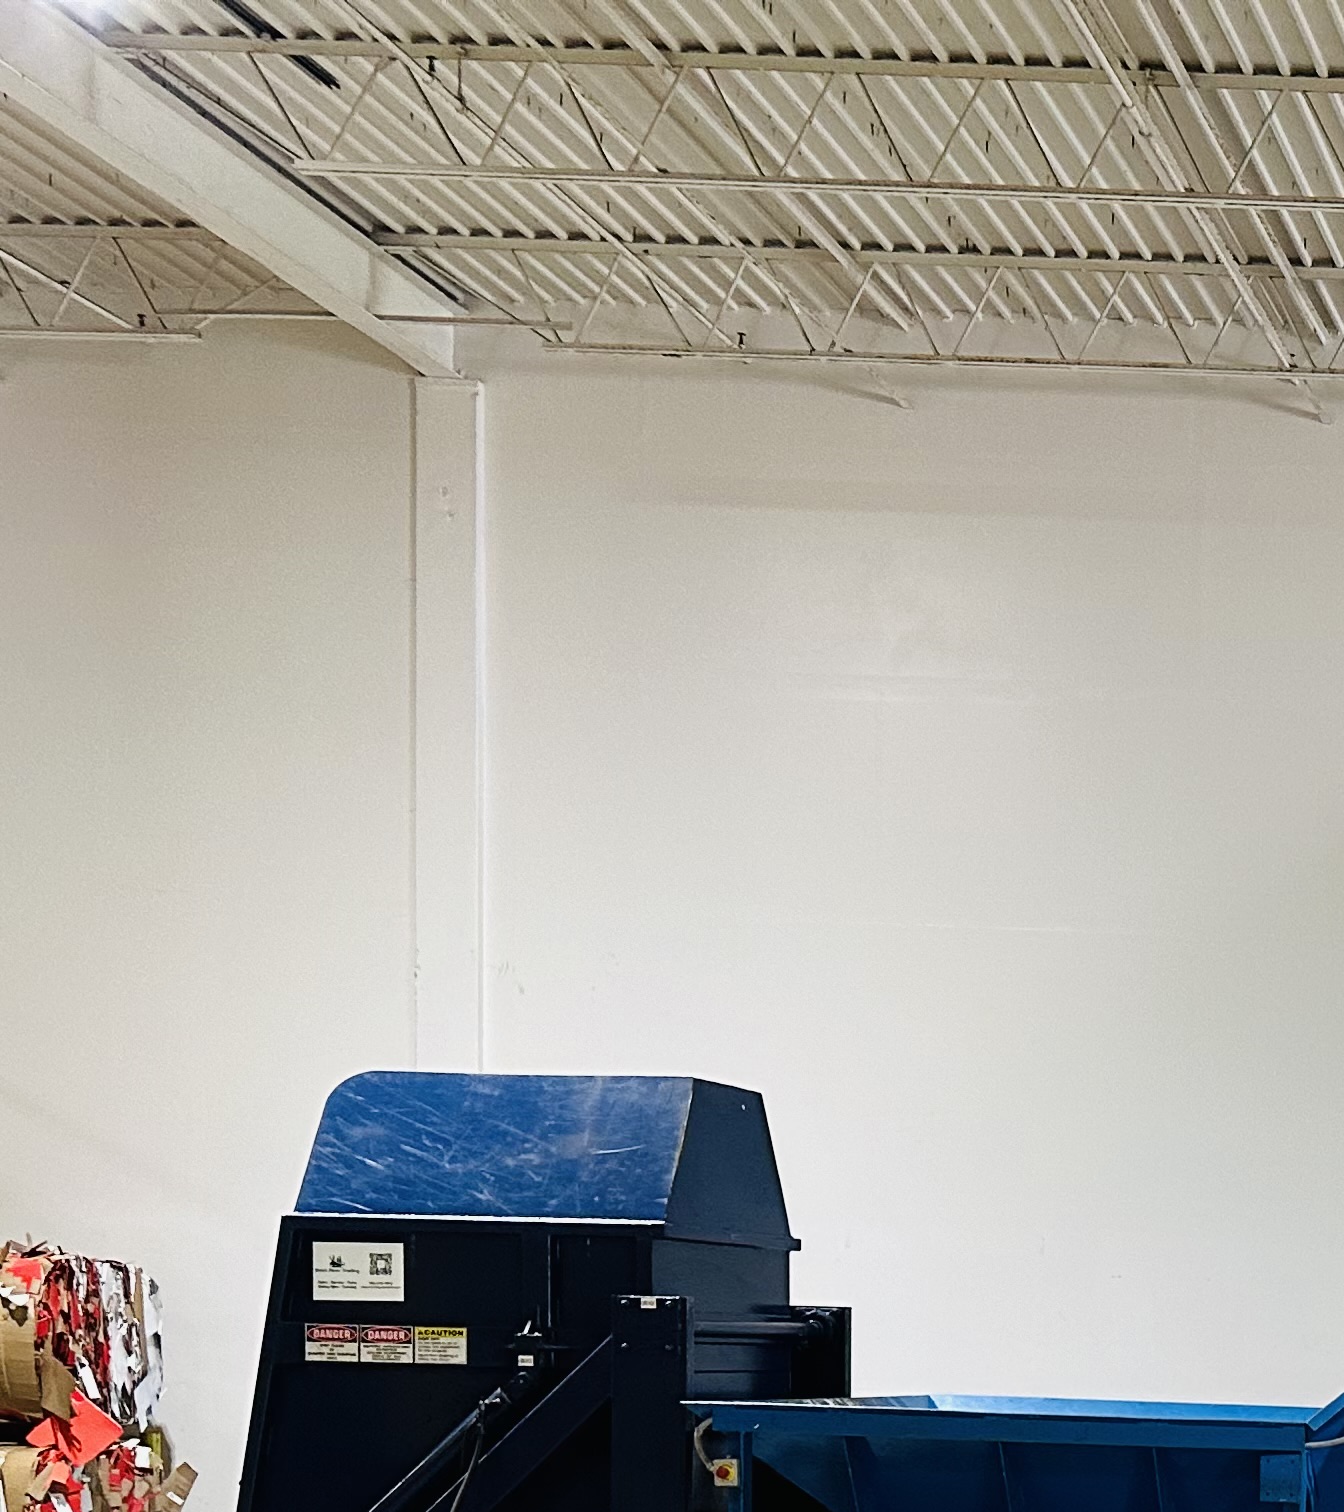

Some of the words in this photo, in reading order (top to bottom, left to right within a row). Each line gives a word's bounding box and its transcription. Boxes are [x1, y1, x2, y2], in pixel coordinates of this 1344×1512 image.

[313, 1329, 351, 1339] DANGER
[367, 1330, 405, 1341] DANGER
[424, 1329, 464, 1337] CAUTION
